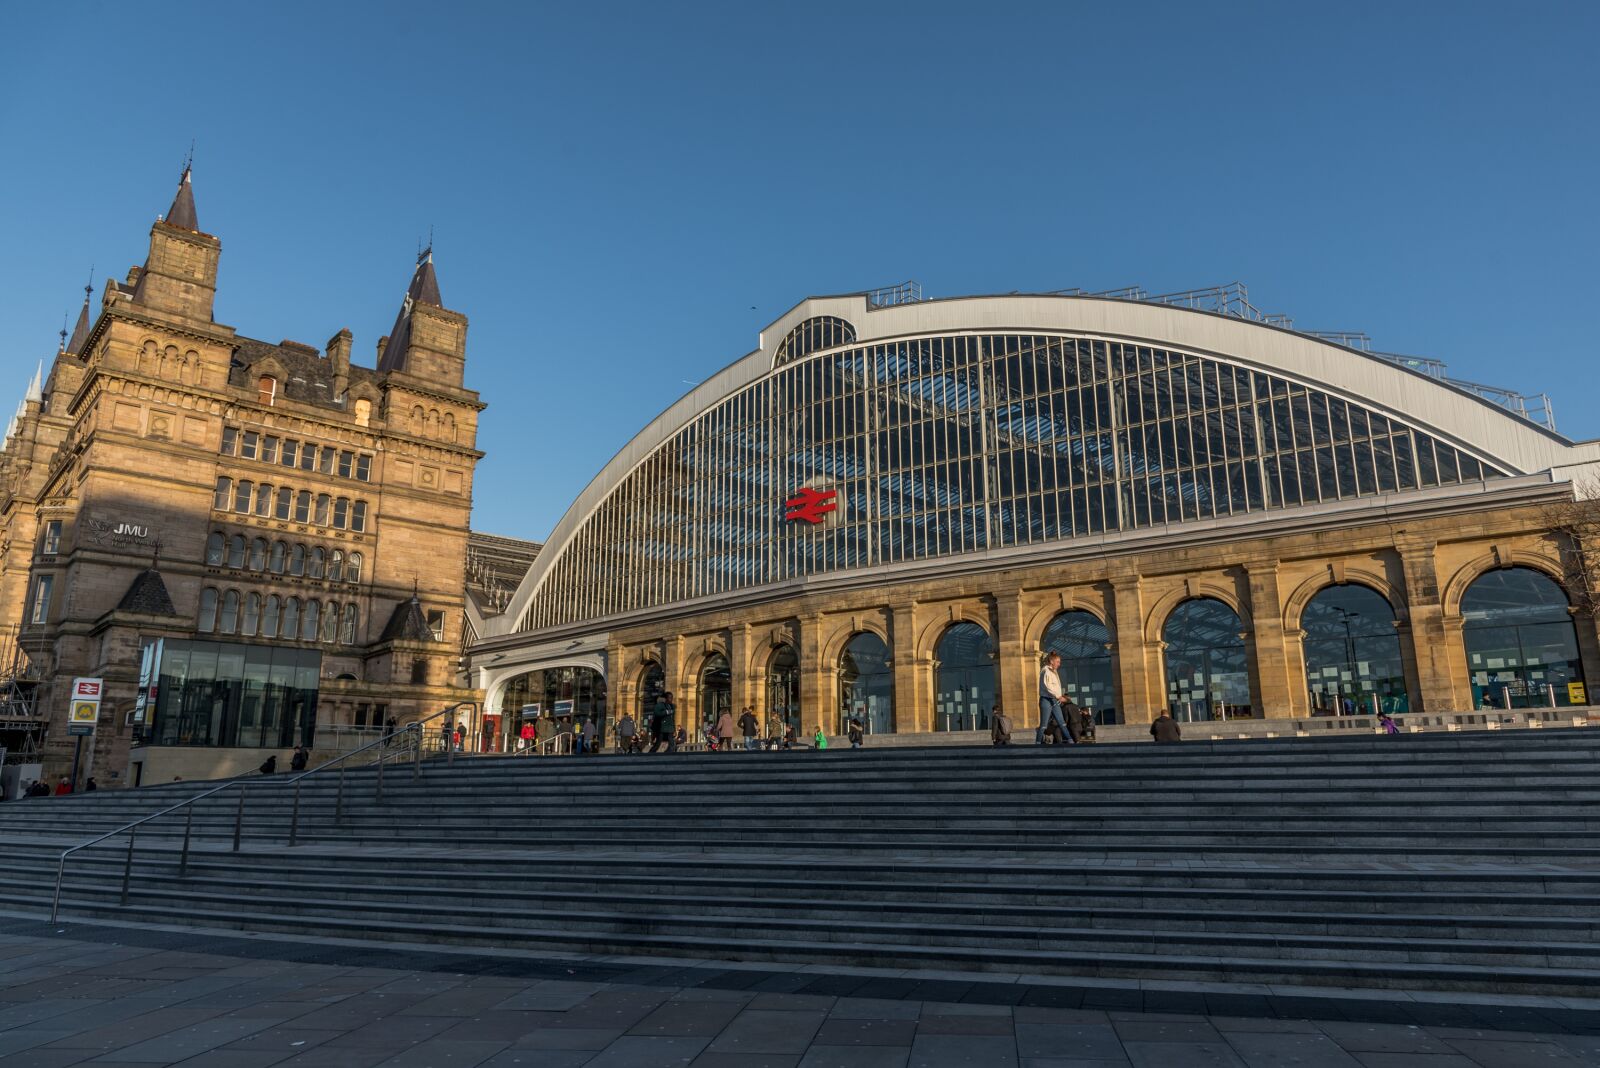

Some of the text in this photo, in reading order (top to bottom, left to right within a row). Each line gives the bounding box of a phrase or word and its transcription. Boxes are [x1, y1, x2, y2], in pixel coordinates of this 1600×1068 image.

[113, 523, 148, 538] JMU
[111, 535, 132, 544] North
[111, 541, 127, 549] Hall
